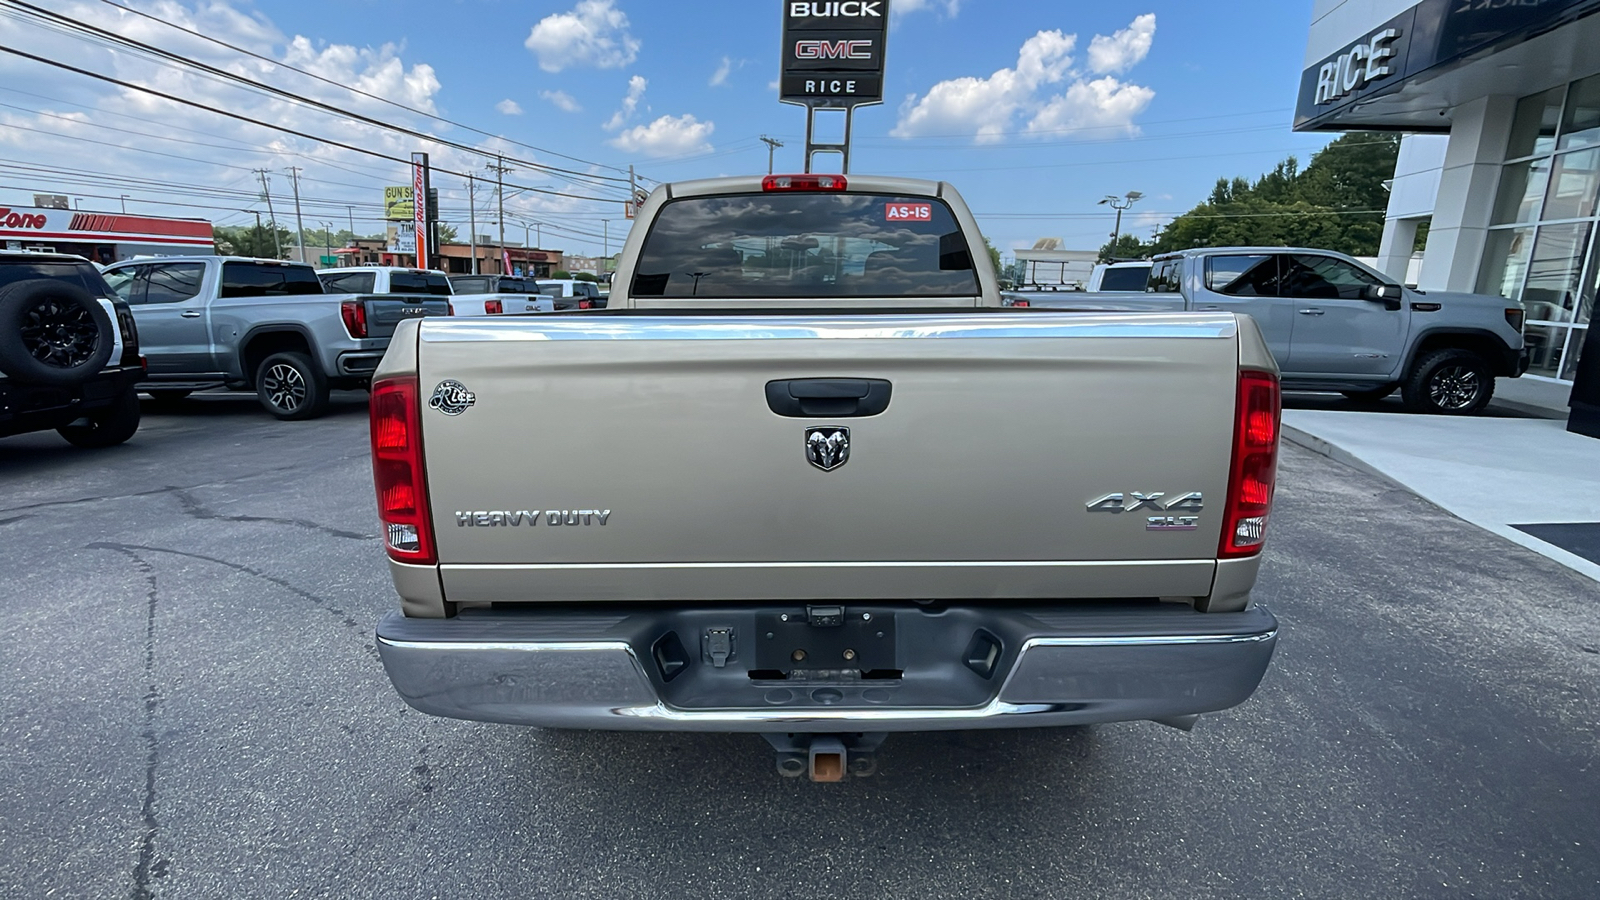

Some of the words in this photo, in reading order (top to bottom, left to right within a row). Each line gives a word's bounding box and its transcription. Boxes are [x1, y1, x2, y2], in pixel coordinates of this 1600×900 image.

[790, 1, 881, 17] BUICK
[795, 40, 872, 59] GMC
[1314, 28, 1396, 106] RICE
[805, 80, 856, 93] RICE
[386, 187, 402, 198] GUN
[414, 161, 423, 223] AutoZone
[888, 206, 930, 218] AS-IS
[429, 387, 476, 409] Rice
[455, 510, 540, 527] HEAVY
[545, 509, 611, 527] DUTY
[1146, 515, 1199, 528] SLT
